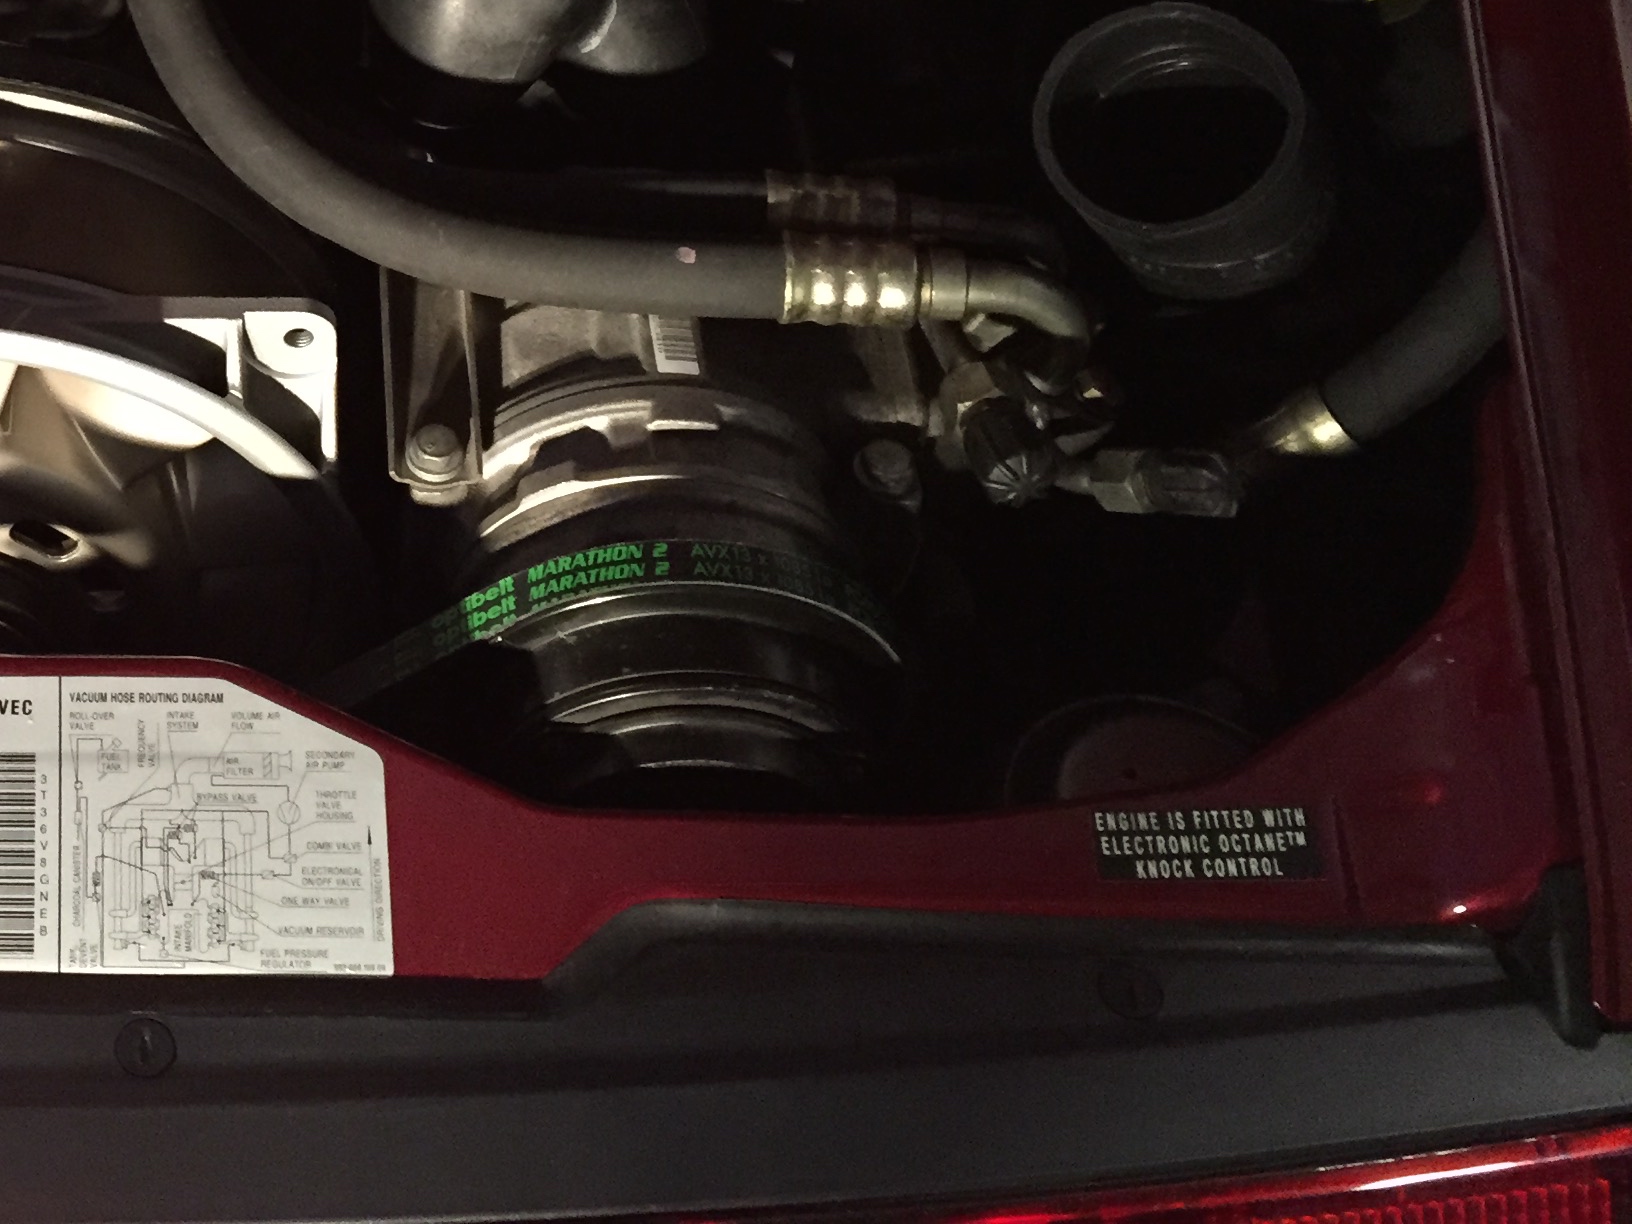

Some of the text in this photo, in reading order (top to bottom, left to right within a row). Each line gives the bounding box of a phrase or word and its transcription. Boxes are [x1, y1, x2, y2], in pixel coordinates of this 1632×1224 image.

[527, 544, 643, 583] MARATHON
[652, 542, 668, 557] 2
[529, 563, 645, 601] MARATHON
[655, 561, 670, 576] 2
[70, 692, 224, 703] VACUUM HOSE ROUTING DIAGRAM
[231, 712, 263, 720] VOLUME
[1095, 808, 1306, 831] ENGINE IS FITTED WITH
[1101, 834, 1210, 855] ELECTRONIC
[1135, 857, 1283, 879] KNOCK CONTROL
